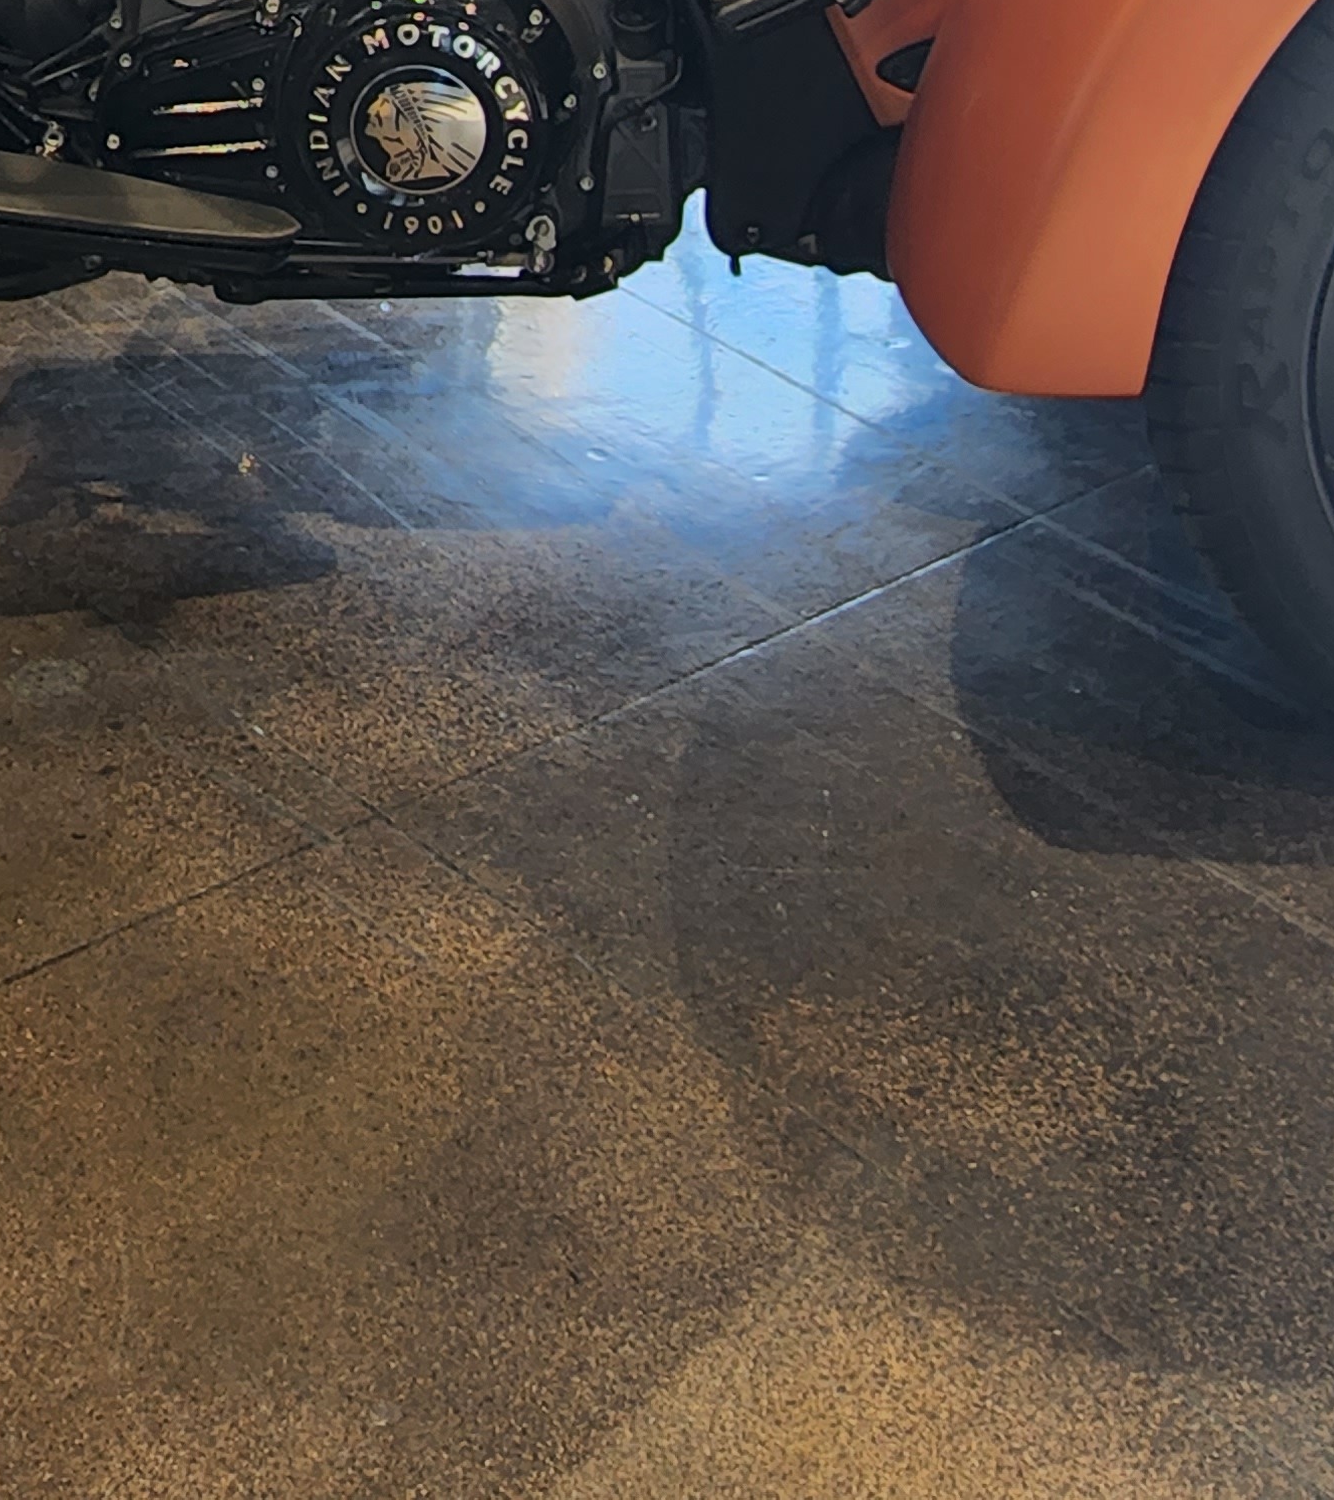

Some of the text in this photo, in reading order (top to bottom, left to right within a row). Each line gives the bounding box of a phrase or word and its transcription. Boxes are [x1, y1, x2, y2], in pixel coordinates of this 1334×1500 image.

[307, 22, 531, 197] INDIAN MOTORCYCLE
[382, 208, 465, 236] 1901
